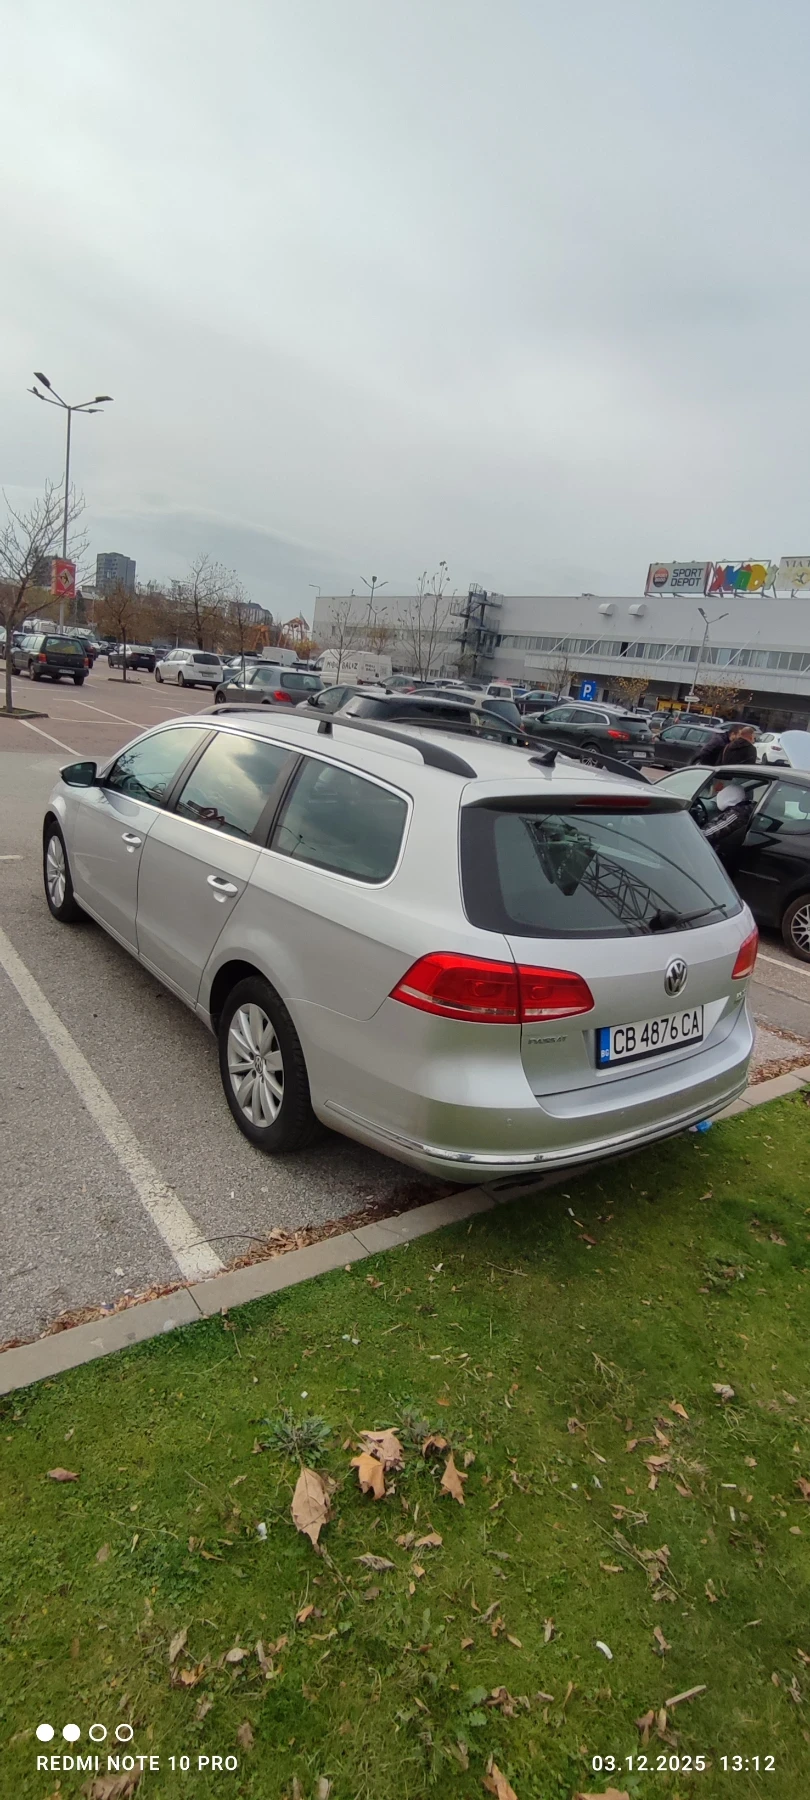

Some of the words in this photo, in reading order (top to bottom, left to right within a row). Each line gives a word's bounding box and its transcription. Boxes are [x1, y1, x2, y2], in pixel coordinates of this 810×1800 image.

[672, 568, 704, 578] SPORT
[670, 577, 702, 587] DEPOT
[583, 684, 592, 698] P
[613, 1026, 636, 1055] CB
[640, 1015, 678, 1049] 4876
[681, 1010, 700, 1038] CA
[600, 1049, 610, 1058] BG
